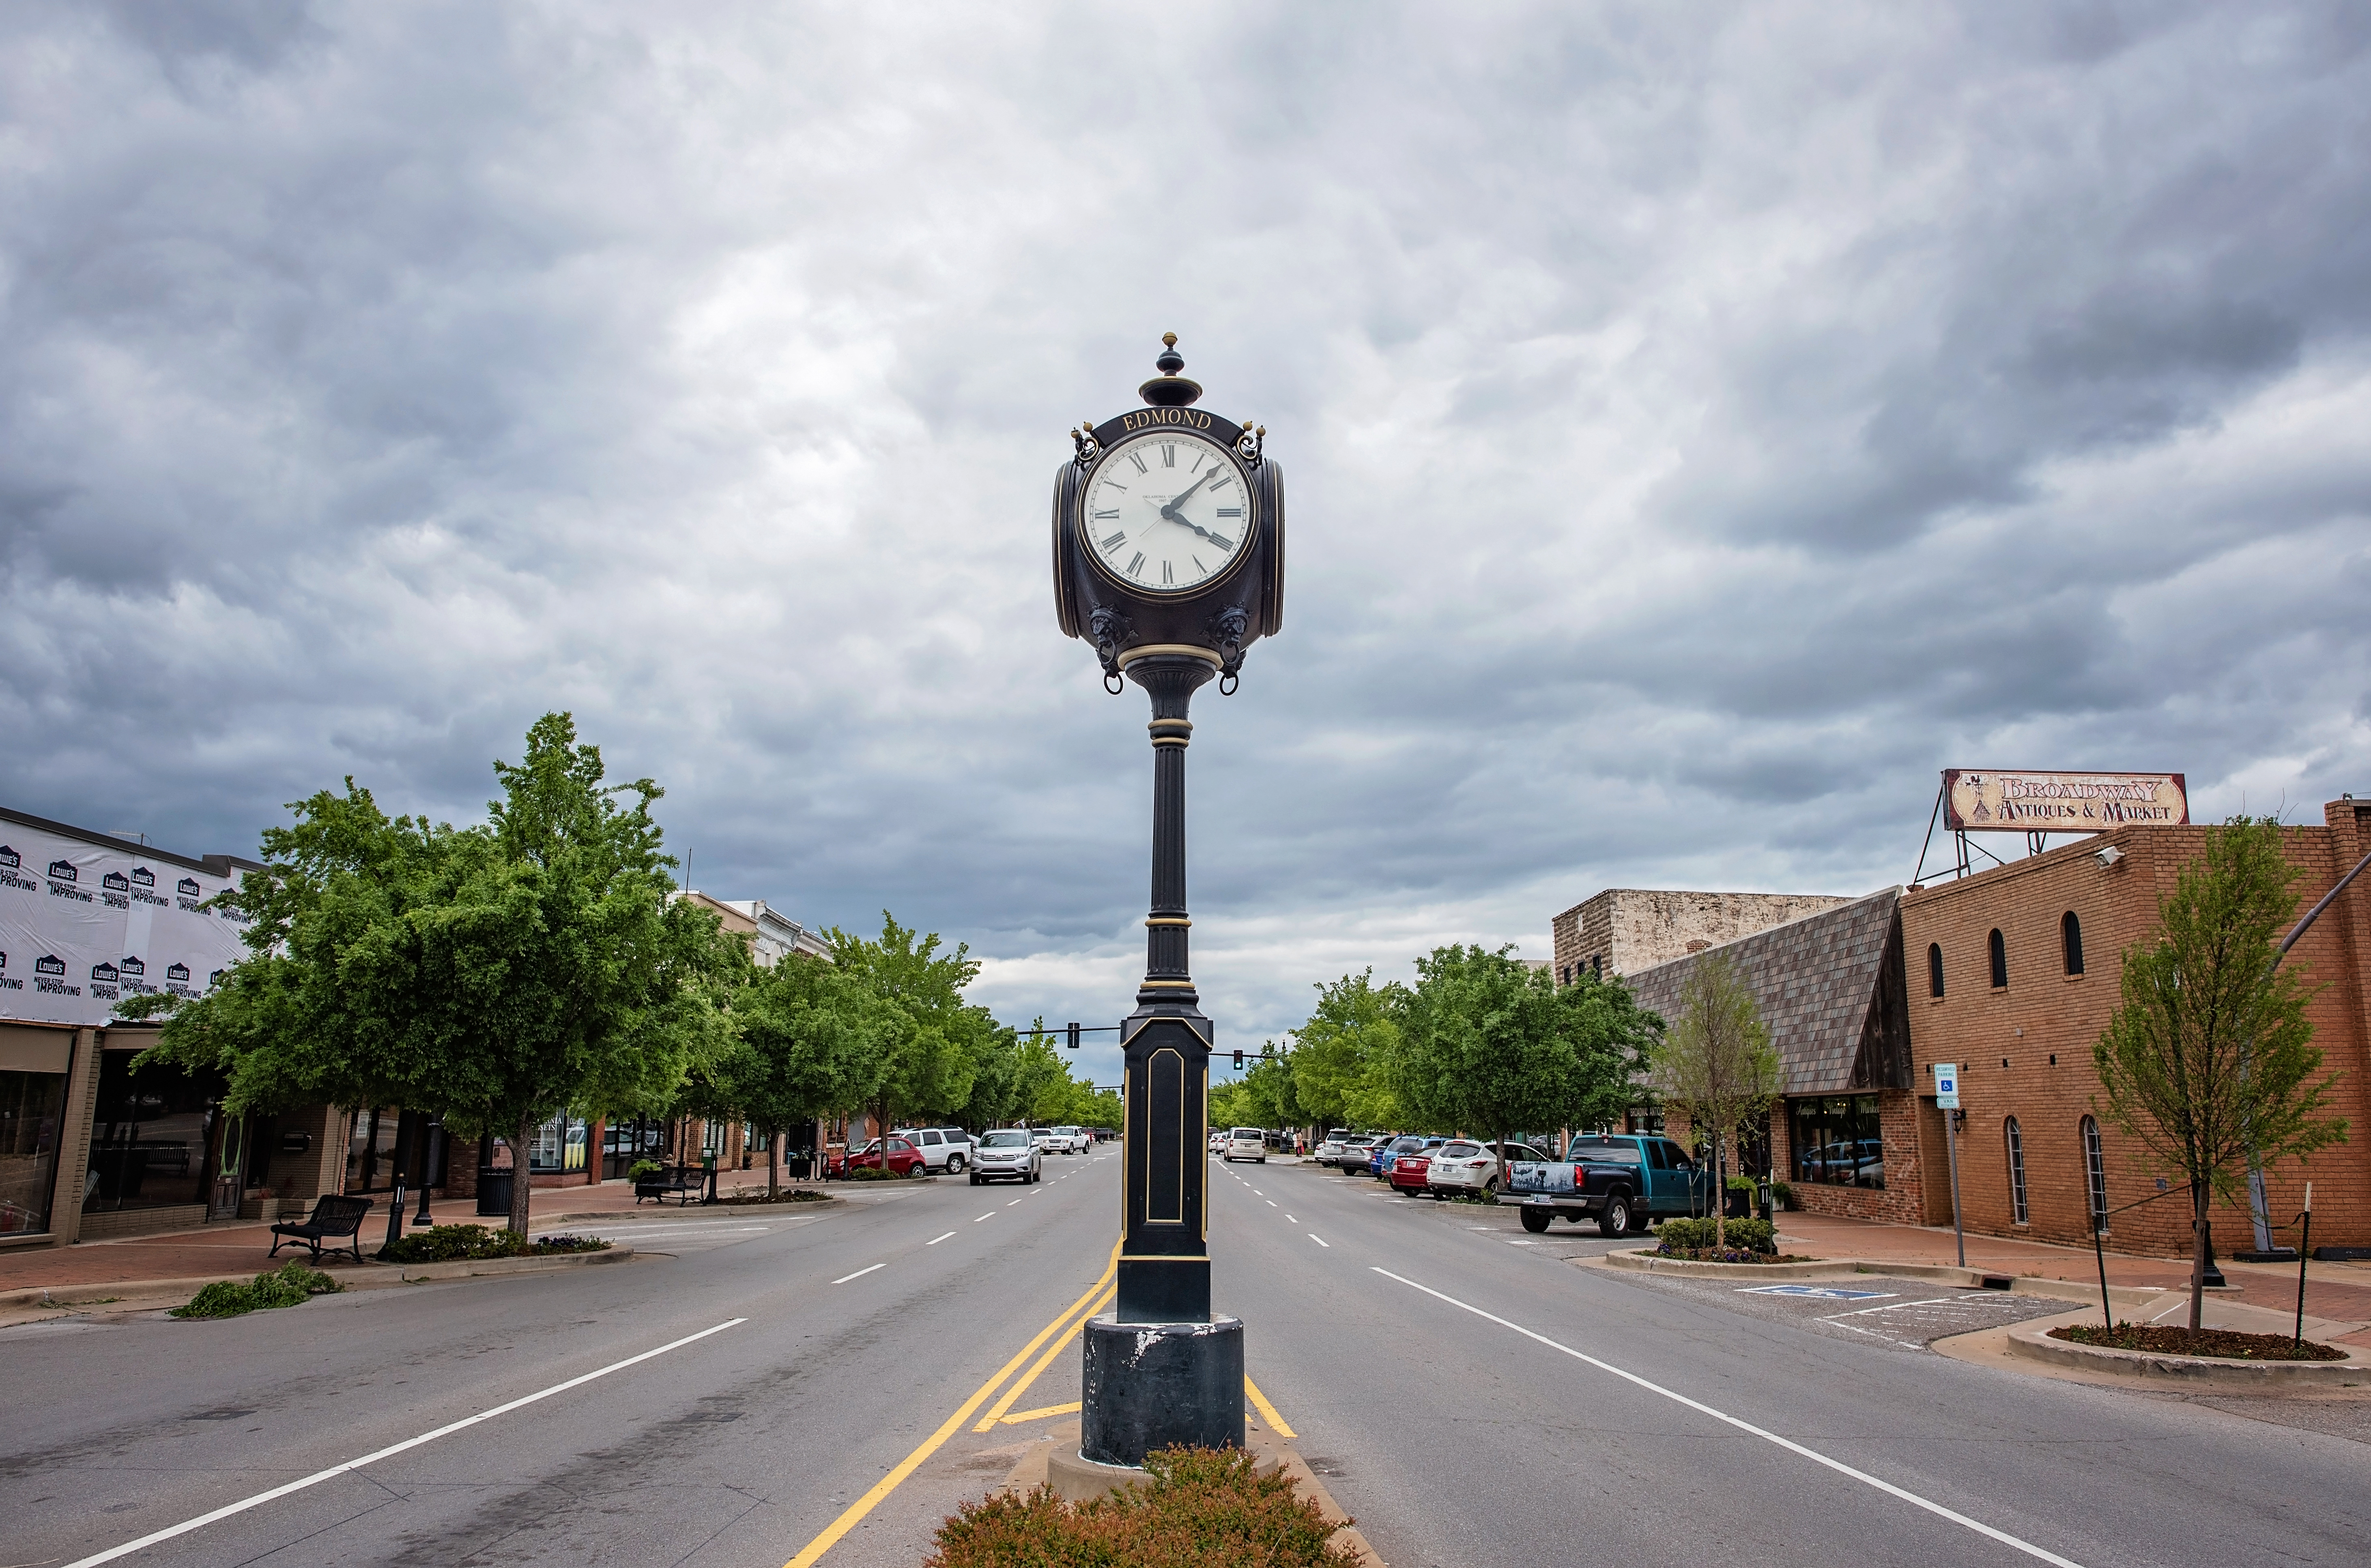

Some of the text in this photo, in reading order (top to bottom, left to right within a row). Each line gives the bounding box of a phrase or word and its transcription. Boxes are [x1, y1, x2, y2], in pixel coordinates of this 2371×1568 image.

[1122, 409, 1212, 431] EDMOND
[1161, 445, 1176, 468] XII
[2000, 778, 2162, 802] BROADWAY
[1995, 800, 2171, 822] ANTIQUES & MARKET
[0, 853, 17, 866] WE'S
[51, 865, 75, 879] LOWE'S
[132, 872, 153, 885] LOWE'S
[0, 874, 37, 891] PROVING
[105, 876, 127, 890] LOWE'S
[180, 882, 198, 895] LOWE'S
[50, 885, 93, 903] IMPROVING
[102, 891, 116, 899] NEVER
[131, 892, 169, 907] IMPROVING
[176, 896, 189, 904] NEVER
[39, 960, 62, 973] LOWE'S
[122, 962, 142, 973] LOWE'S
[95, 968, 116, 980] LOWE'S
[169, 968, 188, 979] LOWE'S
[0, 977, 23, 990] OVING
[37, 983, 81, 997] IMPROVING
[120, 982, 157, 994] IMPROVING
[1649, 1106, 1663, 1117] ANTIQU
[1796, 1103, 1816, 1119] Antiques
[1825, 1102, 1846, 1119] Vintage
